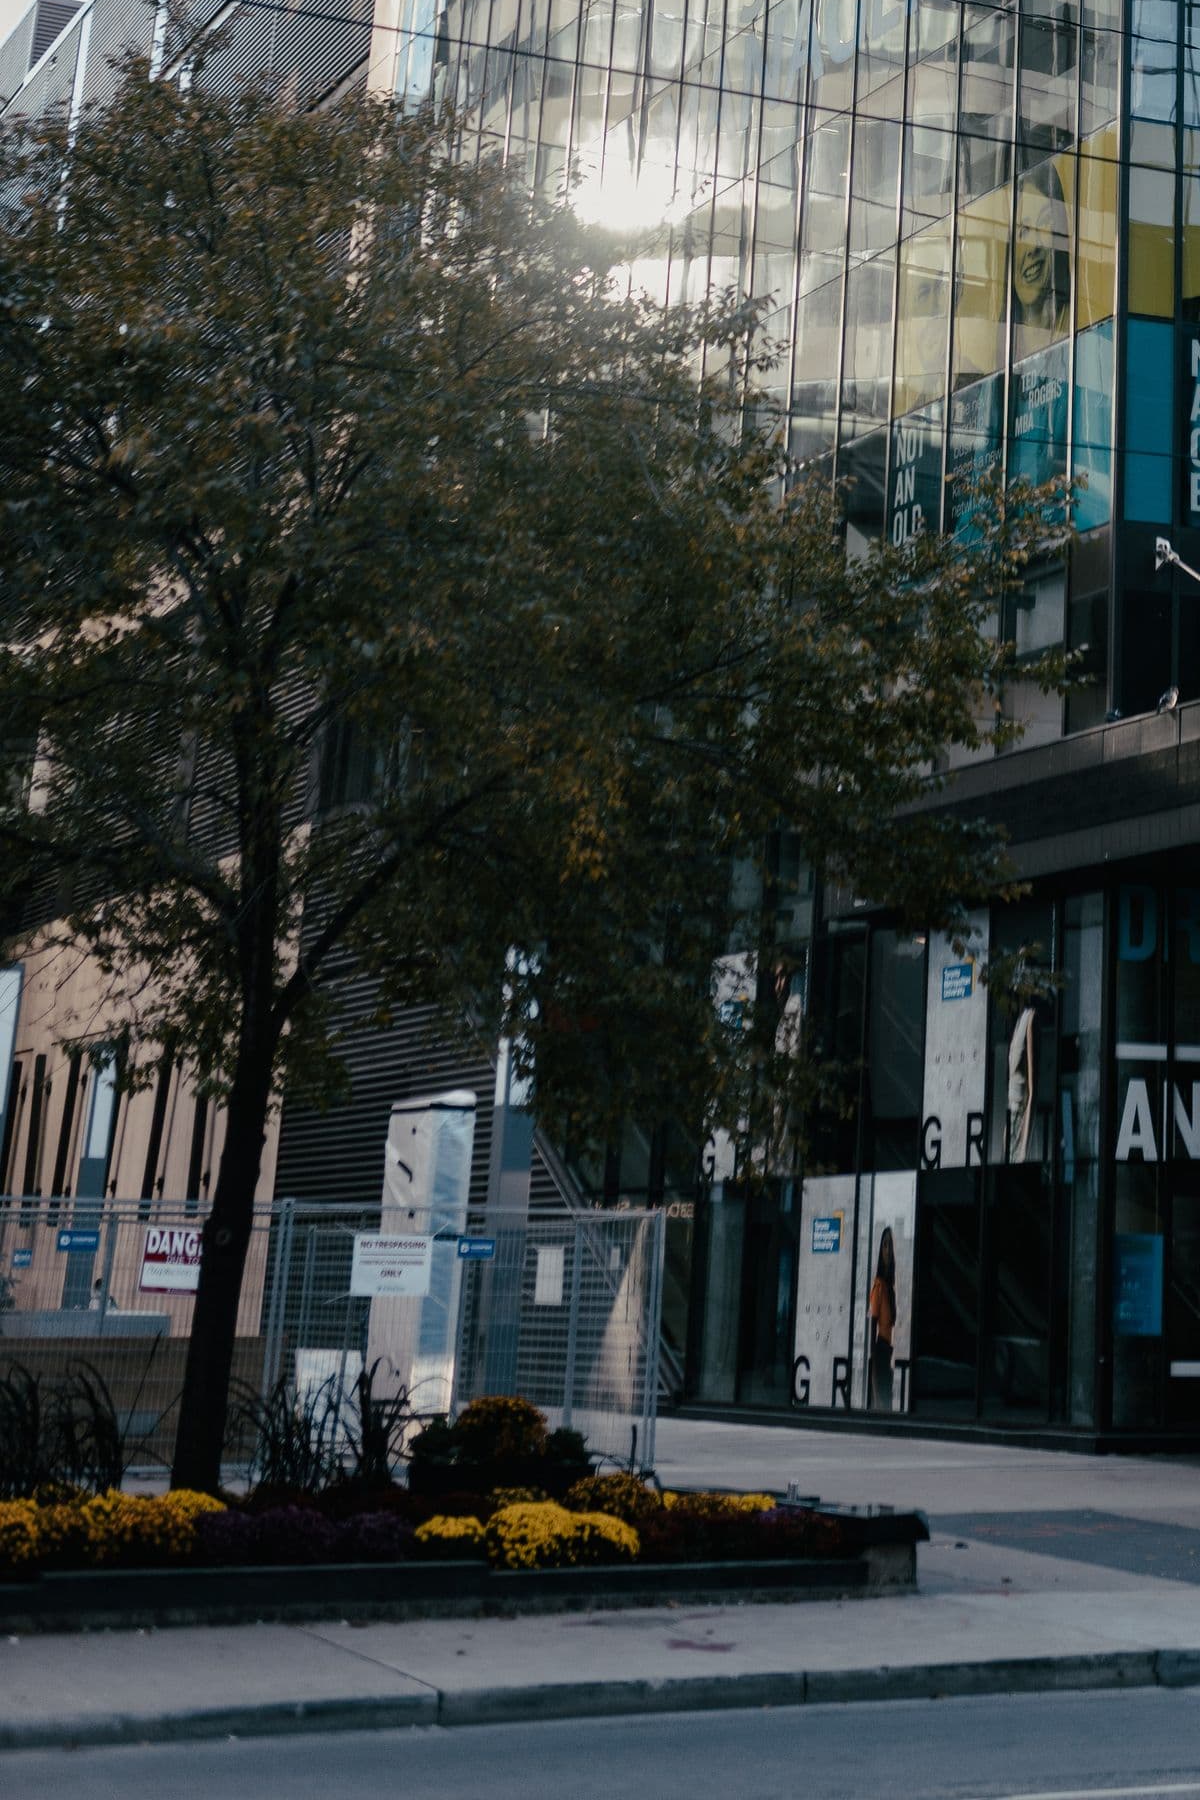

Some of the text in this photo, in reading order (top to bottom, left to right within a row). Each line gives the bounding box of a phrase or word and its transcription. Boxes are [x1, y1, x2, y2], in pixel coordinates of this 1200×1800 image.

[1021, 369, 1037, 393] TED
[1029, 378, 1062, 410] ROGERS
[1015, 411, 1034, 438] MBA
[896, 420, 924, 467] NOT
[894, 465, 916, 508] AN
[146, 1229, 204, 1257] DANG
[375, 1240, 427, 1249] TRESPASSING
[379, 1269, 403, 1279] ONLY
